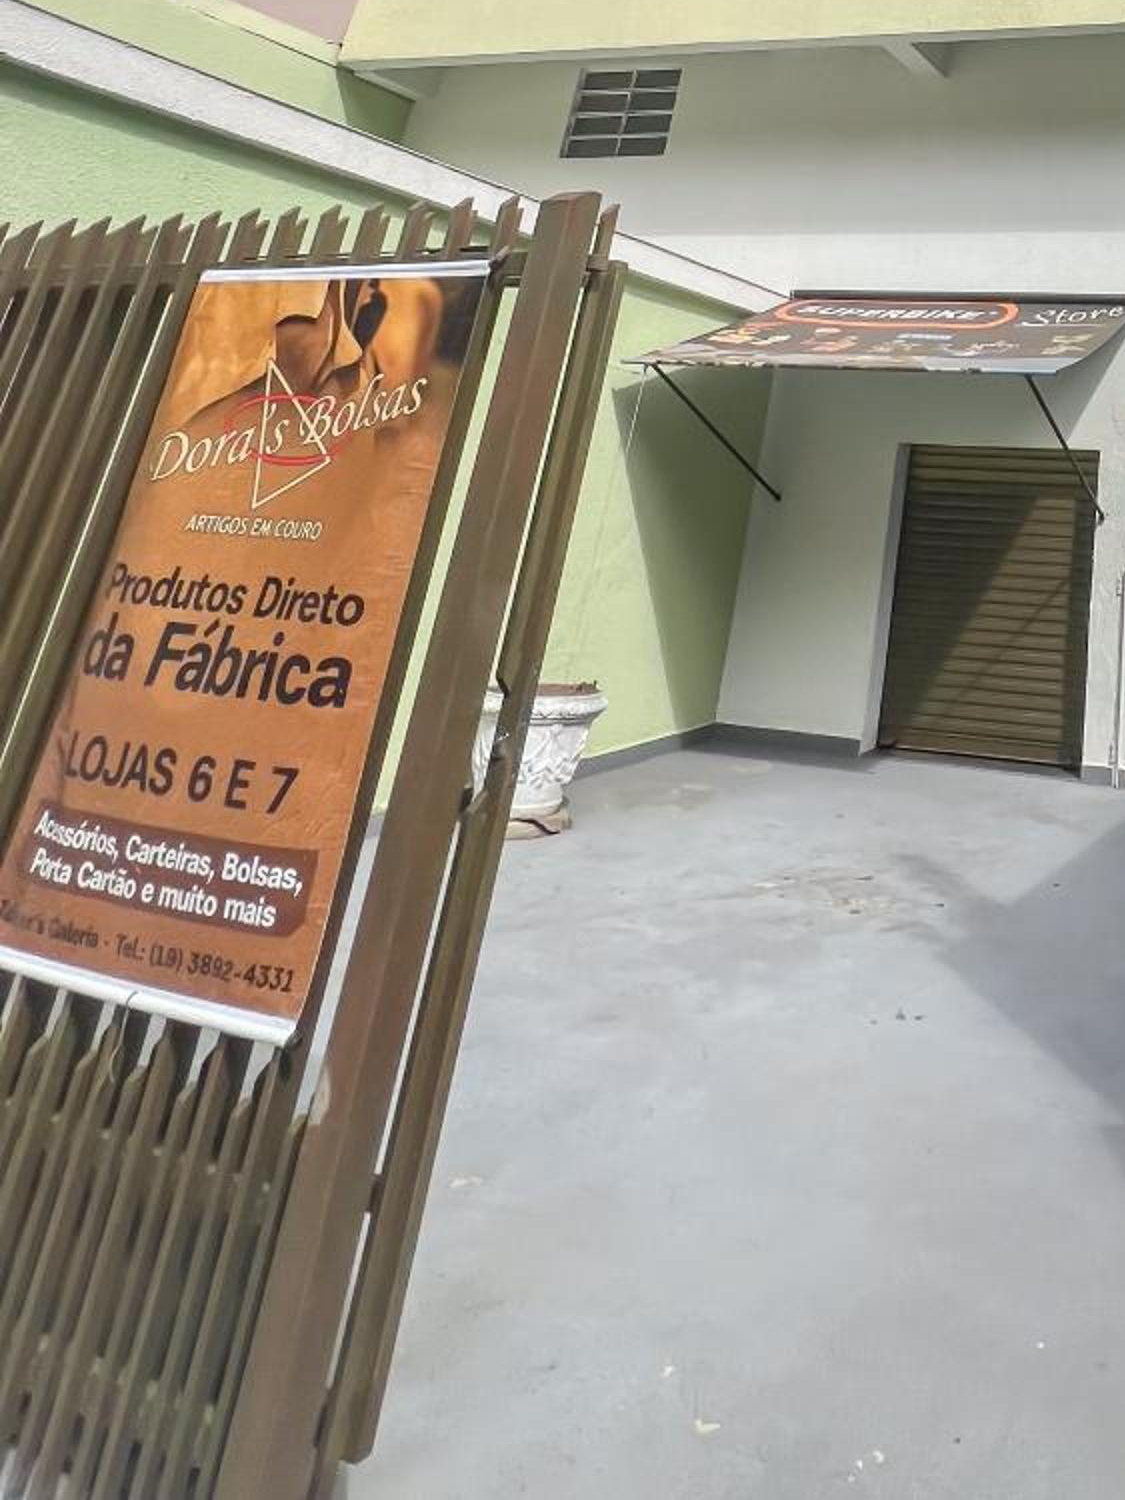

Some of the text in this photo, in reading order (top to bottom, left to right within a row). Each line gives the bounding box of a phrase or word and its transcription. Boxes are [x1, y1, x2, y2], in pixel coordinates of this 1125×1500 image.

[797, 305, 1124, 328] SUPERBIKE Store
[151, 373, 428, 481] Dora's Bolsas
[183, 514, 323, 540] ARTIGOS EM COURO
[106, 562, 366, 627] Produtos Direto
[83, 611, 353, 708] da Fábrica
[63, 730, 300, 815] LOJAS 6 E 7
[30, 847, 277, 928] Porta Cartão e muito mais
[125, 835, 215, 885] Carteiras,
[221, 852, 304, 897] Bolsas,
[187, 950, 295, 993] 3892-4331
